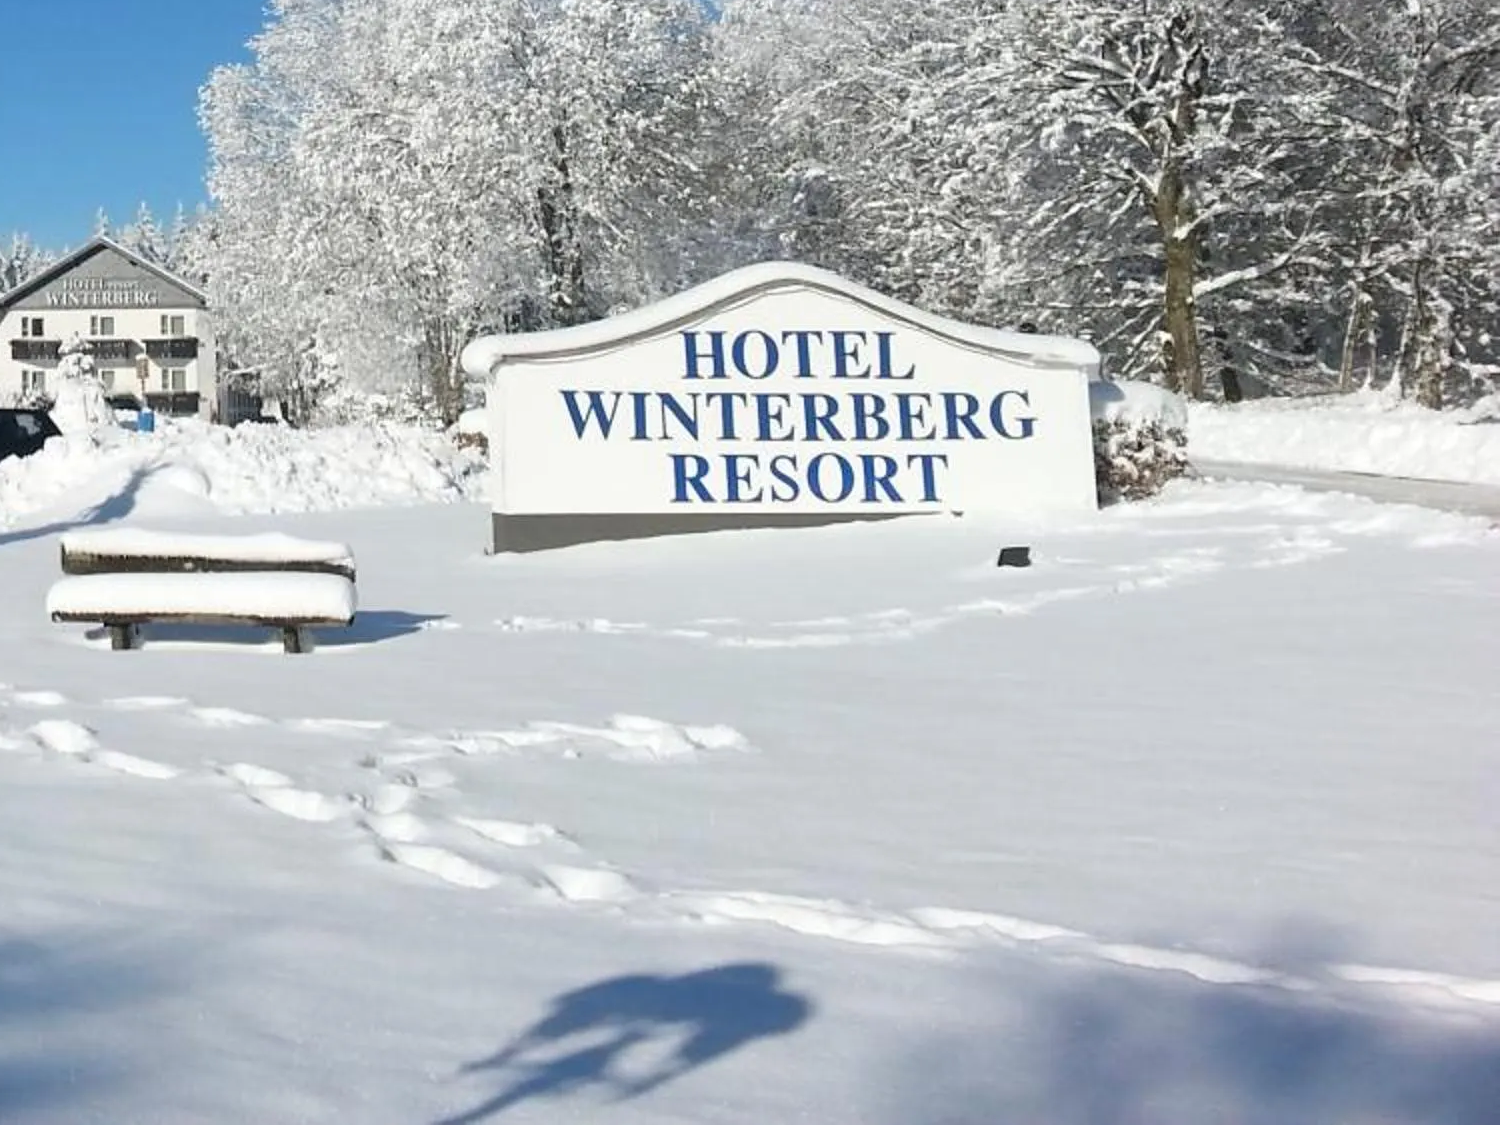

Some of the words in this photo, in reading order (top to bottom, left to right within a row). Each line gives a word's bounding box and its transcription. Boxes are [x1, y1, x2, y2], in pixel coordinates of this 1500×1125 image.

[46, 290, 159, 306] WINTERBERG
[62, 277, 104, 290] HOTEL
[681, 330, 915, 380] HOTEL
[560, 390, 1037, 442] WINTERBERG
[669, 453, 948, 503] RESORT
